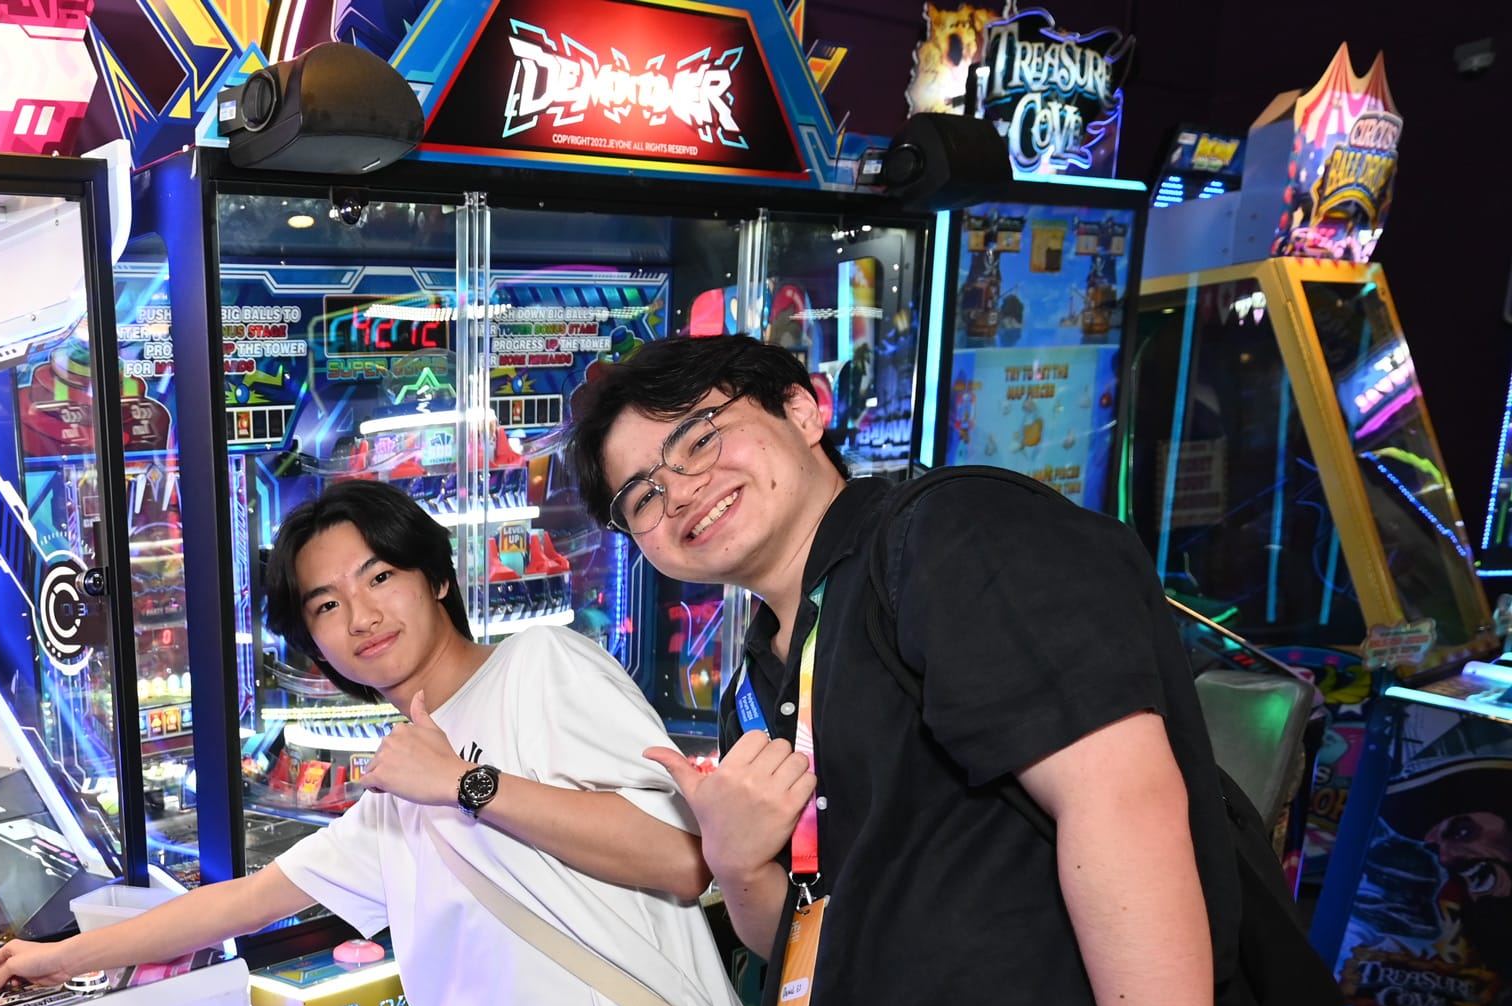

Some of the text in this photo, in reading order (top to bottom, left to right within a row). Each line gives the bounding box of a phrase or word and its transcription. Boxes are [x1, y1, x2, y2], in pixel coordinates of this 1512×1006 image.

[988, 23, 1114, 108] TREASURE
[1008, 93, 1083, 166] COVE
[1350, 117, 1400, 149] CIRCUS
[243, 307, 281, 322] BALLS
[282, 307, 301, 322] TO
[517, 306, 545, 320] DOWN
[547, 307, 564, 320] BIG
[248, 325, 288, 339] STAGE
[237, 341, 263, 356] THE
[264, 340, 307, 356] TOWER
[493, 336, 611, 352] PROGRESS UP THE TOWER
[124, 361, 152, 376] FOR
[327, 358, 388, 380] SUPER
[503, 527, 525, 536] LEVEL
[508, 534, 521, 544] UP
[1358, 961, 1474, 998] TREASURE
